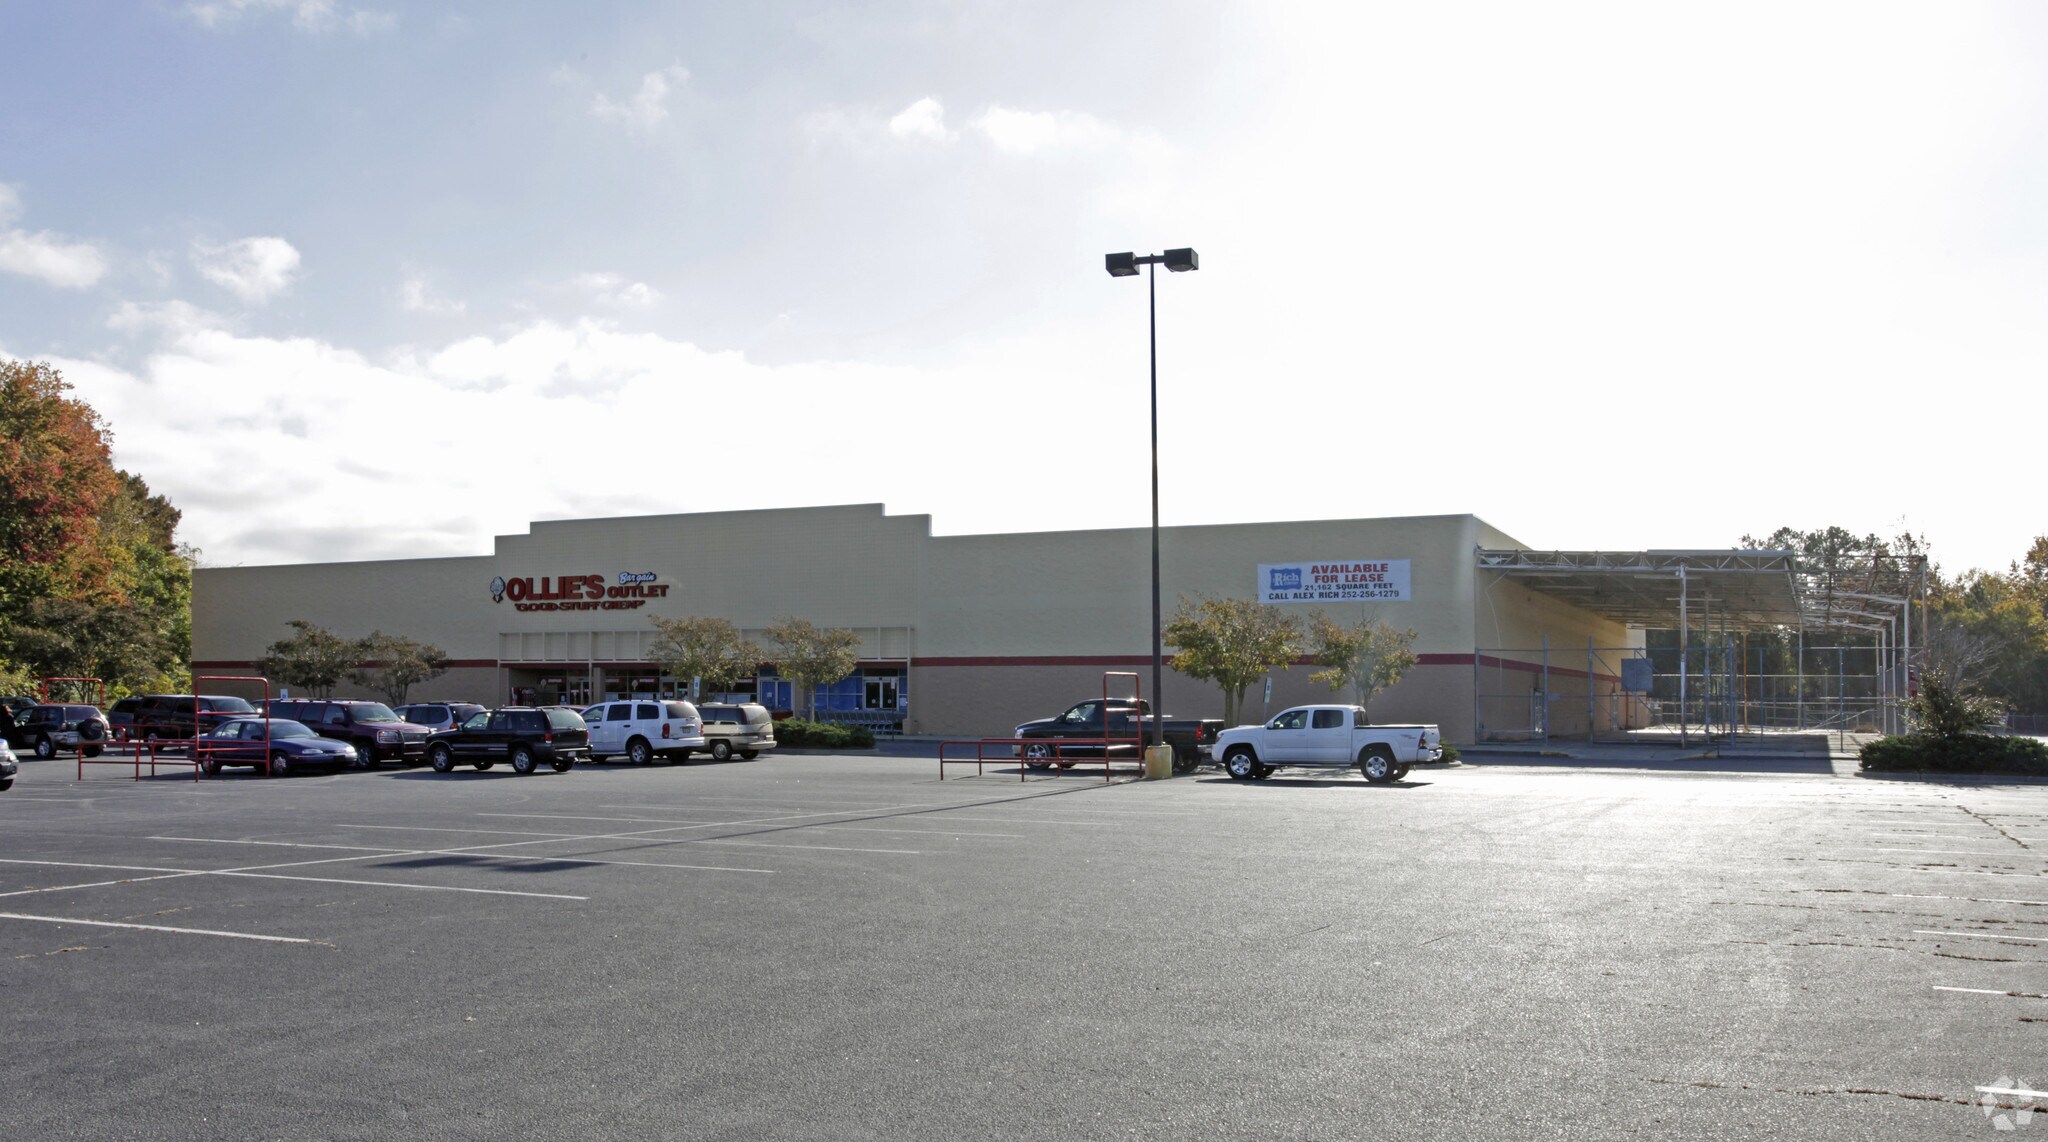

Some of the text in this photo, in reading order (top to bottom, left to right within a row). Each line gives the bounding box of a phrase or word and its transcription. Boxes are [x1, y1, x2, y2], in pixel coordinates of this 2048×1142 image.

[1311, 563, 1389, 574] AVAILABLE
[619, 572, 656, 585] Bargain
[1274, 572, 1300, 586] Rich
[1314, 573, 1385, 583] FOR LEASE
[506, 575, 670, 601] OLLIE'S OUTLET
[1335, 583, 1370, 591] SQUARE
[1268, 590, 1400, 600] CALL ALEX RICH 252-256-1279
[559, 602, 601, 611] STUFF
